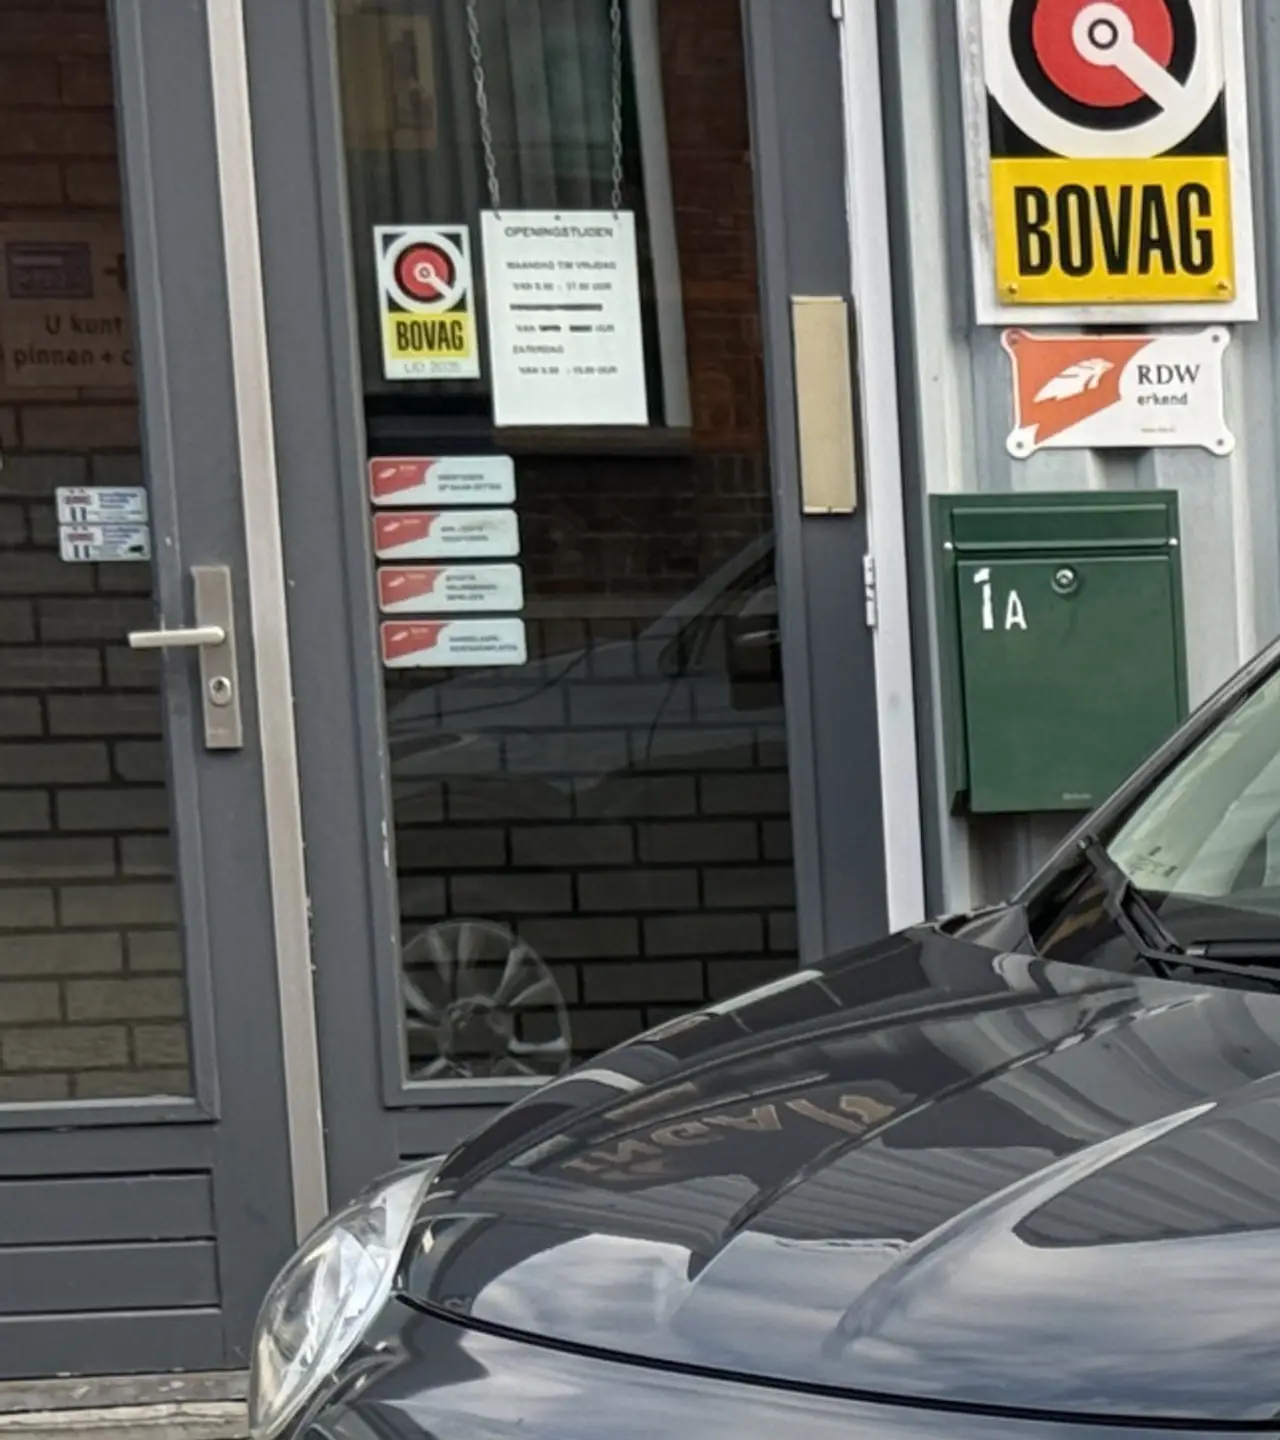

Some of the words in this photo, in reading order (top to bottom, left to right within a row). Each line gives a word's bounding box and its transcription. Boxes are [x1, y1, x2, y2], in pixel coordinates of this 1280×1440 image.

[1013, 181, 1215, 277] BOVAG
[396, 320, 464, 352] BOVAG
[1137, 364, 1201, 386] RDW
[1137, 392, 1189, 406] erkend
